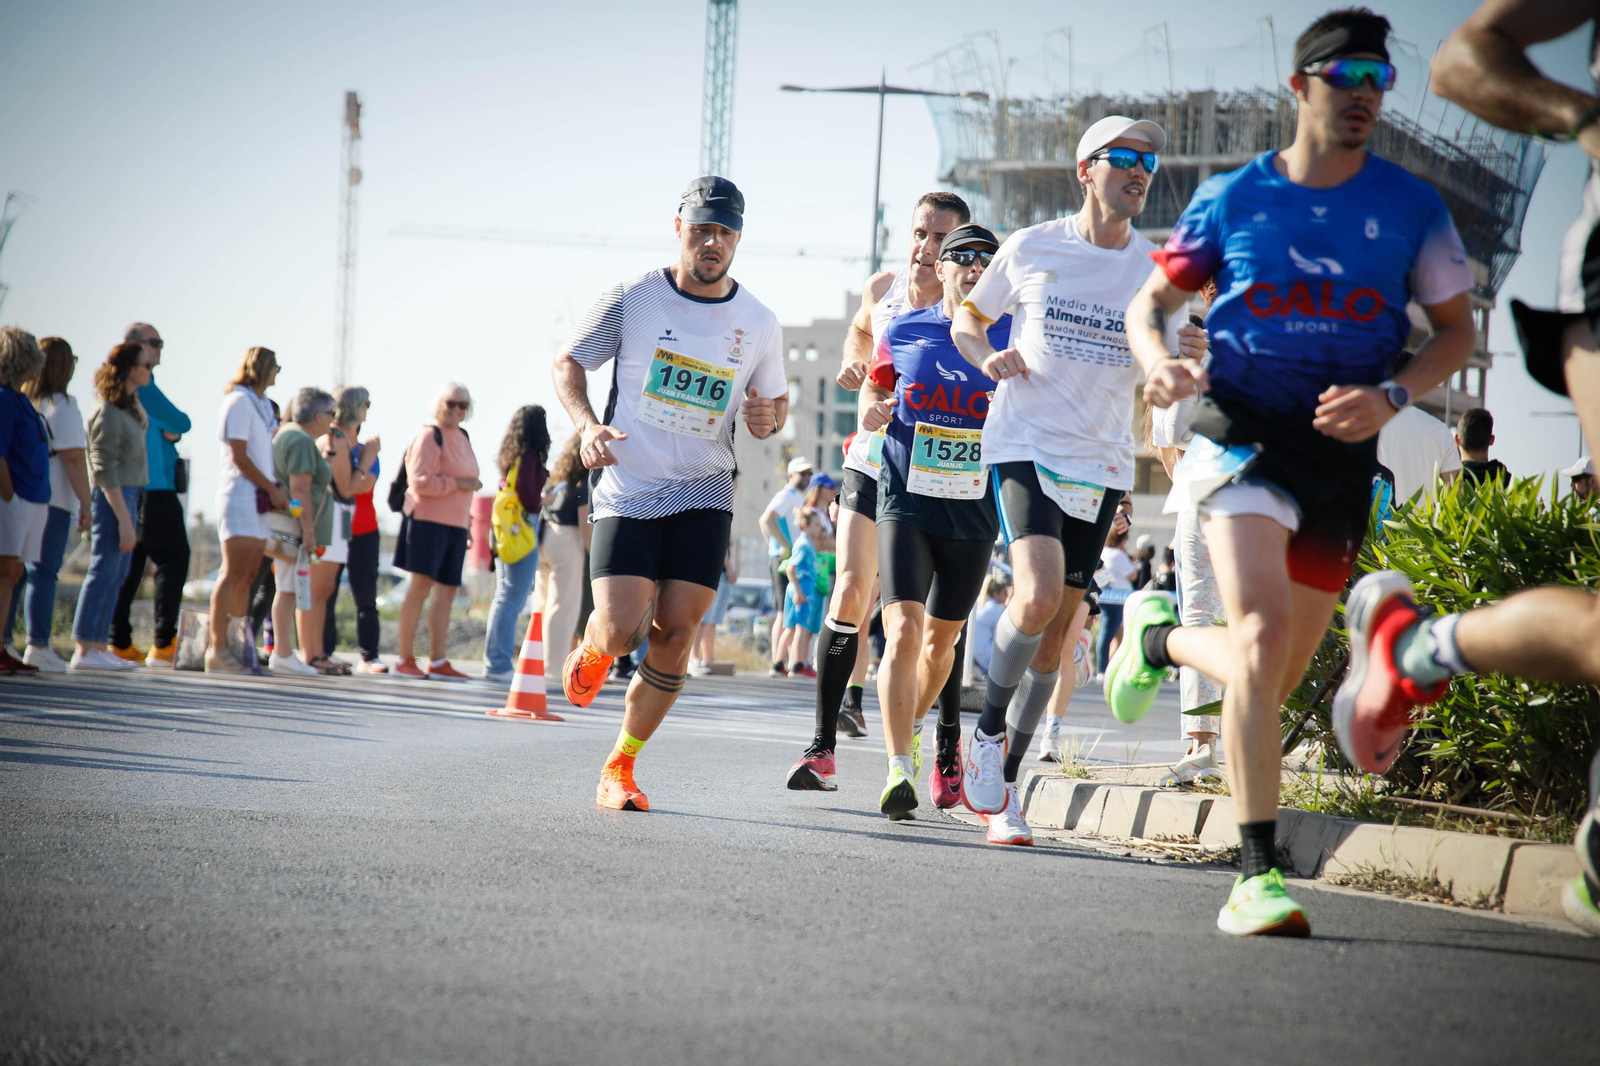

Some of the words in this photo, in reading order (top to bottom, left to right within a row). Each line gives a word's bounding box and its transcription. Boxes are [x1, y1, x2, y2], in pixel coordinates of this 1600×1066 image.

[1046, 295, 1087, 312] Medio
[1242, 279, 1386, 323] GALO
[1045, 307, 1102, 329] Almería
[1284, 320, 1339, 334] SPORT
[1043, 323, 1075, 335] RAMÓN
[1077, 329, 1098, 339] RUIZ
[659, 365, 727, 401] 1916
[656, 387, 676, 397] JUAN
[676, 392, 717, 408] FRANCISCO
[905, 382, 991, 419] GALO
[929, 413, 963, 425] SPORT
[923, 437, 981, 462] 1528
[936, 461, 964, 469] JUANJO
